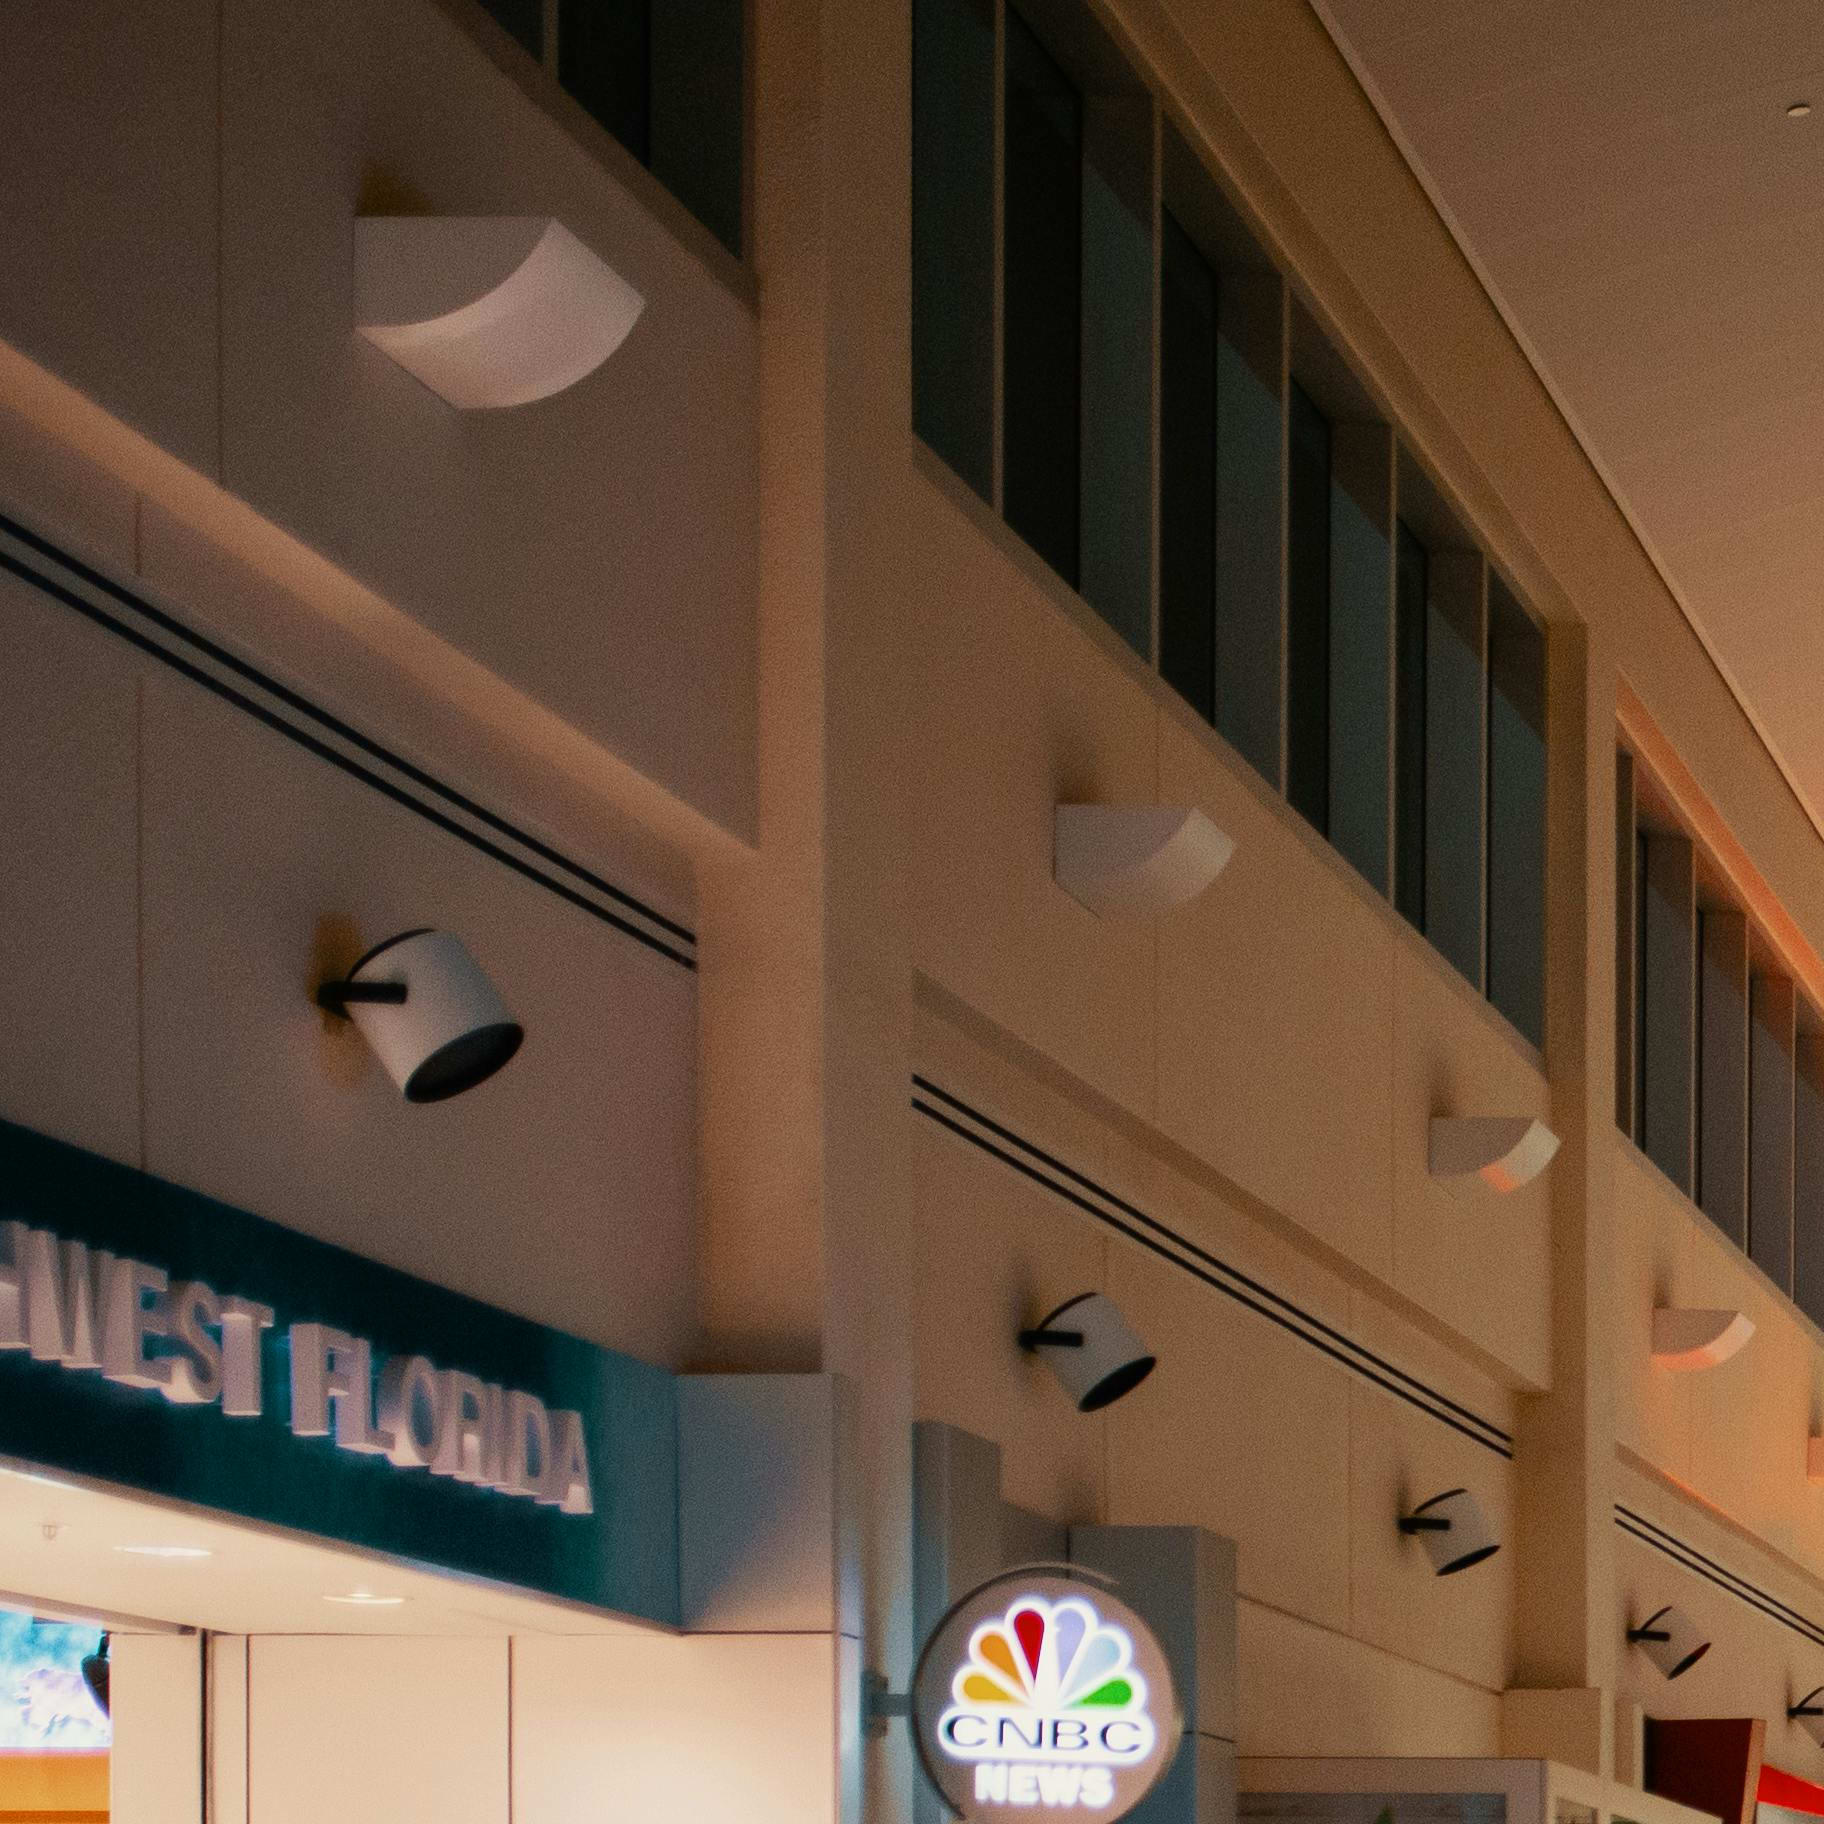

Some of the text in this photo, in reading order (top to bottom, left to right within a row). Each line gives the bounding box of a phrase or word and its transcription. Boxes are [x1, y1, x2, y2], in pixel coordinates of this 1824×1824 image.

[289, 1322, 595, 1515] FLORIDA
[945, 1715, 1147, 1753] CNBC
[974, 1763, 1114, 1807] NEWS
